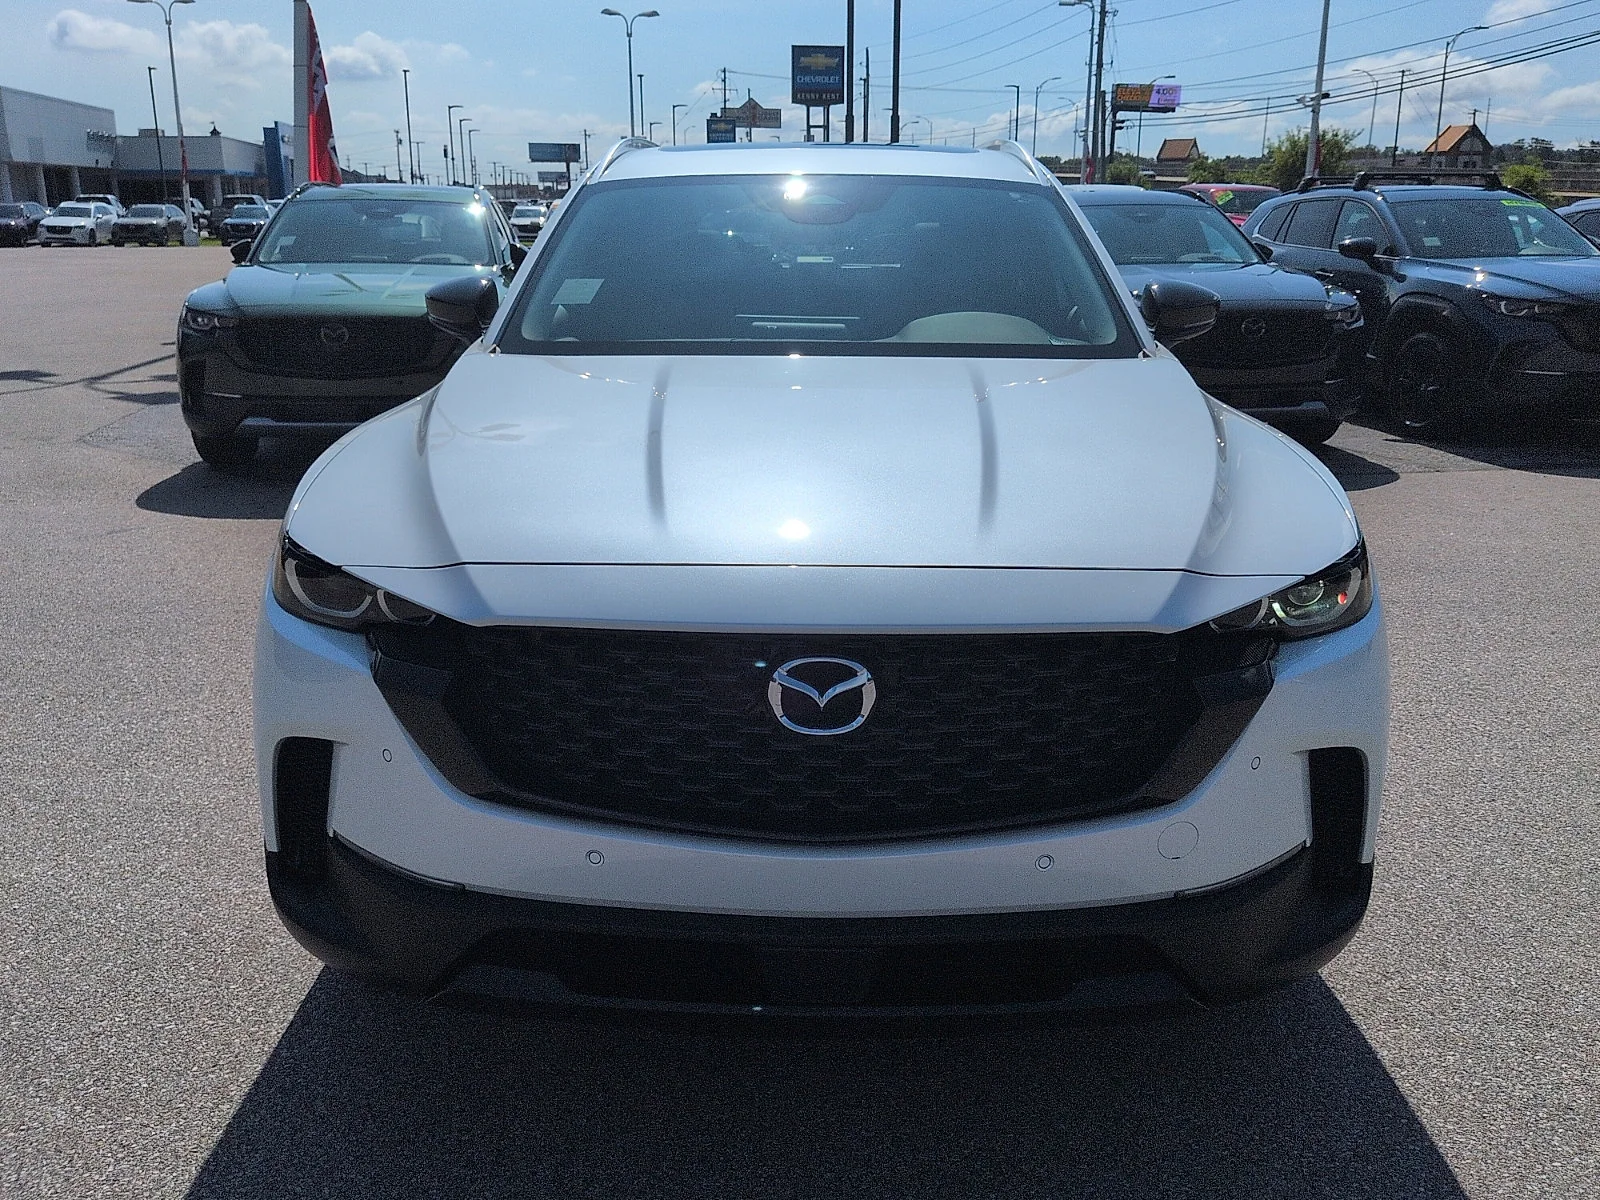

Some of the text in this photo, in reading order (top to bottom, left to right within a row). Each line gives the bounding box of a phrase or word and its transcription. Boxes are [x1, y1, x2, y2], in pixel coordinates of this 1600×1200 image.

[796, 75, 840, 83] CHEVROLET
[796, 92, 840, 100] KENNY KENT
